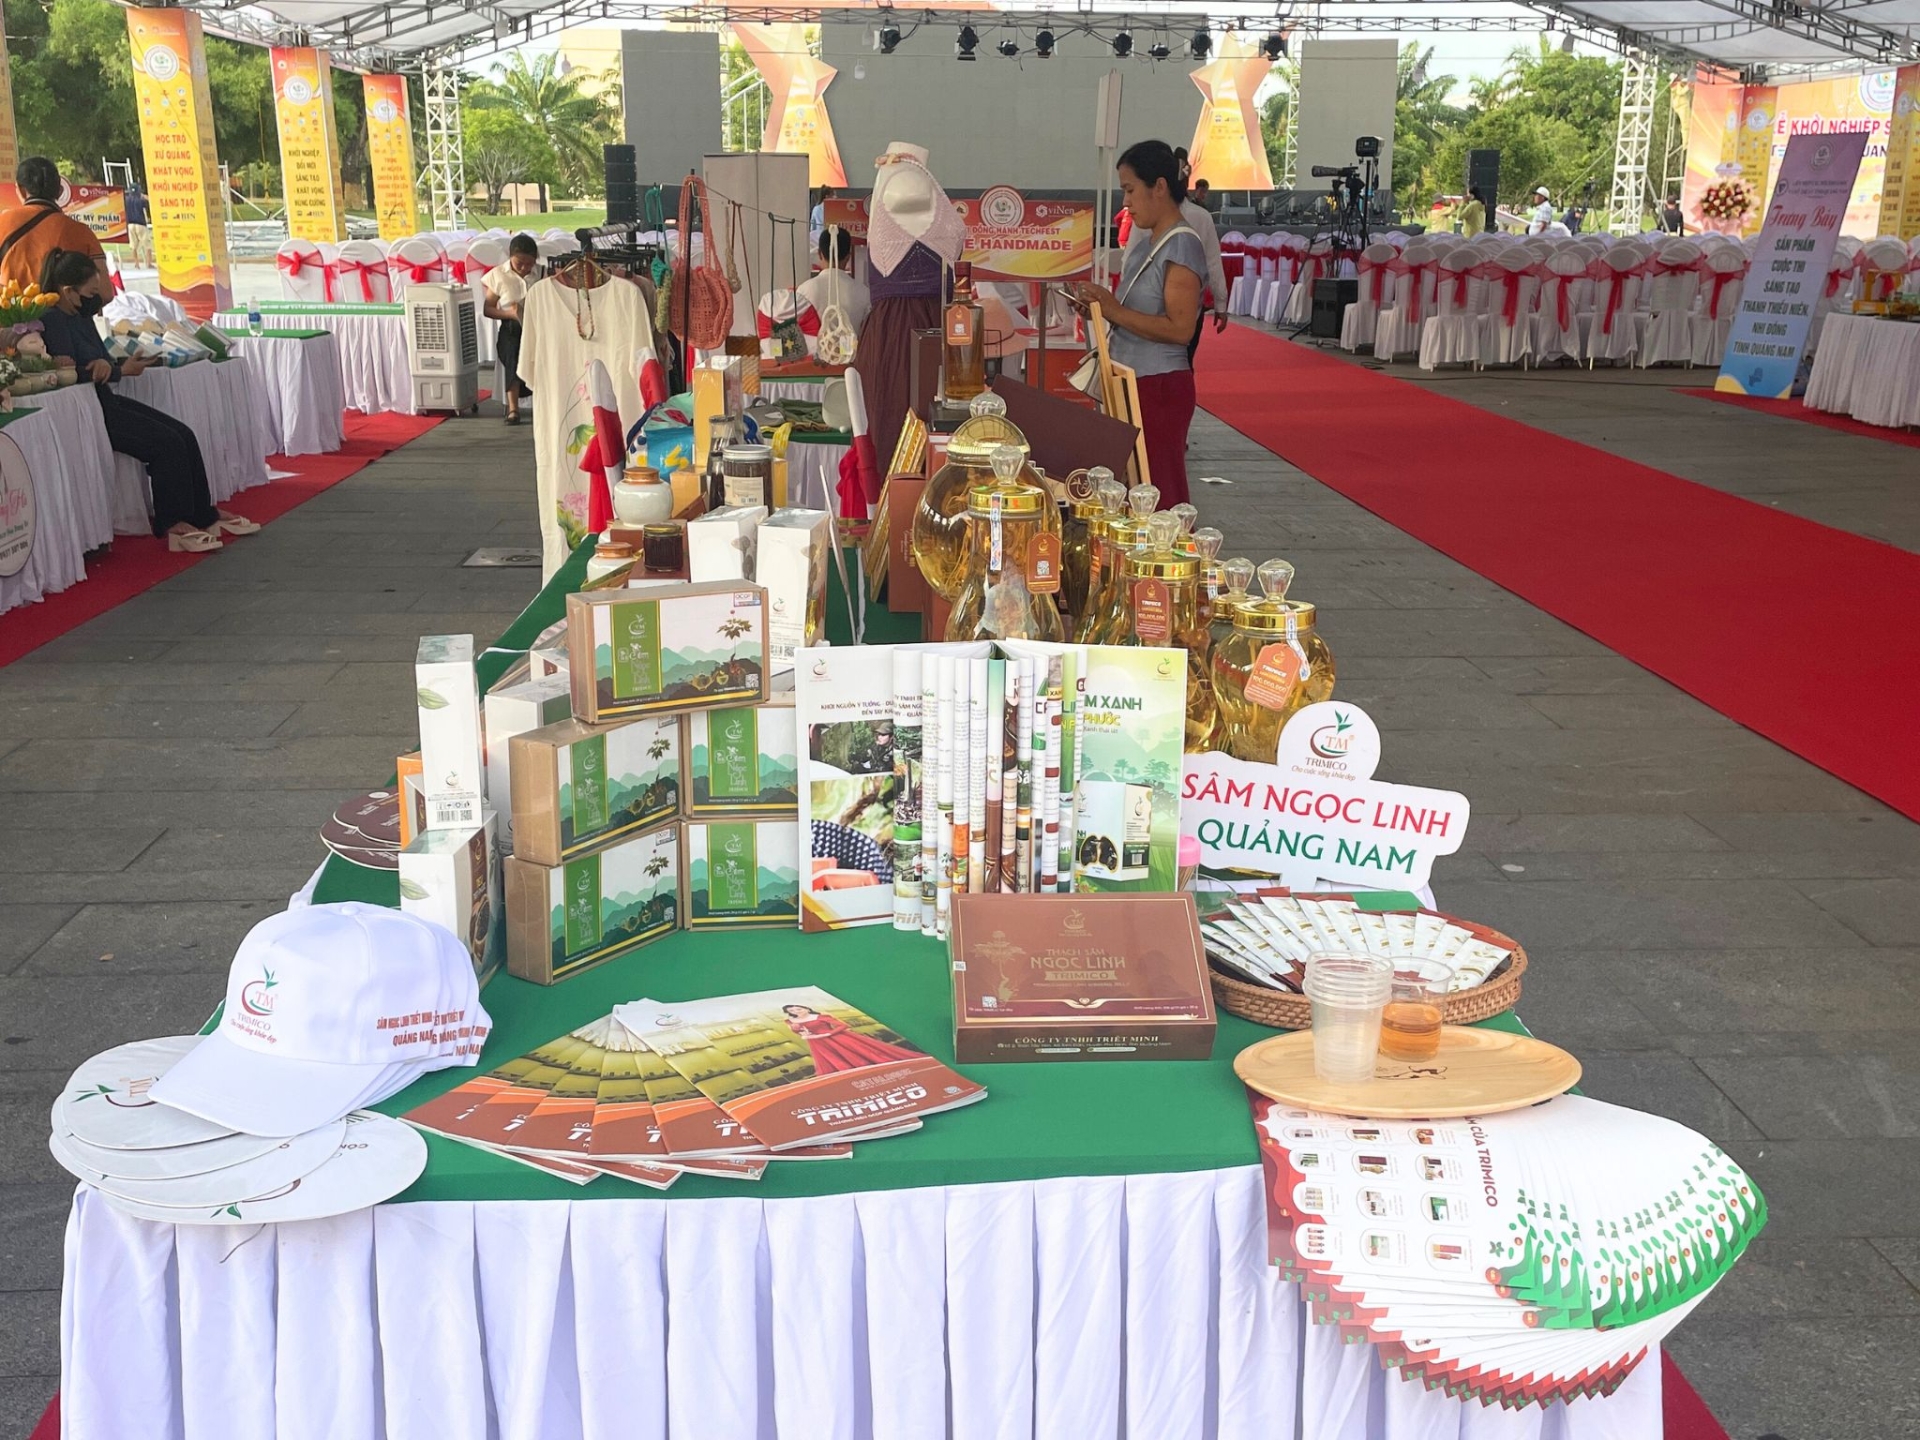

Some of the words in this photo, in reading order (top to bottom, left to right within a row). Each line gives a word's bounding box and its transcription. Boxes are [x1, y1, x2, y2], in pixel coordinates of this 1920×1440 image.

[1049, 205, 1074, 214] viNen
[981, 239, 1072, 250] HANDMADE
[1101, 696, 1142, 710] XANH
[1325, 734, 1350, 751] TM
[1305, 757, 1347, 771] TRIMICO
[1182, 770, 1256, 808] SÂM
[1264, 784, 1366, 824] NGỌC
[1372, 801, 1451, 837] LINH
[1198, 818, 1325, 860] QUẢNG
[1335, 838, 1418, 874] NAM
[1030, 956, 1082, 972] NGỌC
[1086, 956, 1126, 969] LINH
[1054, 972, 1110, 980] TRIMICO
[256, 990, 274, 1009] TM
[1014, 1036, 1046, 1044] CÔNG
[1470, 1126, 1488, 1146] CỦA
[1477, 1148, 1498, 1208] TRIMICO
